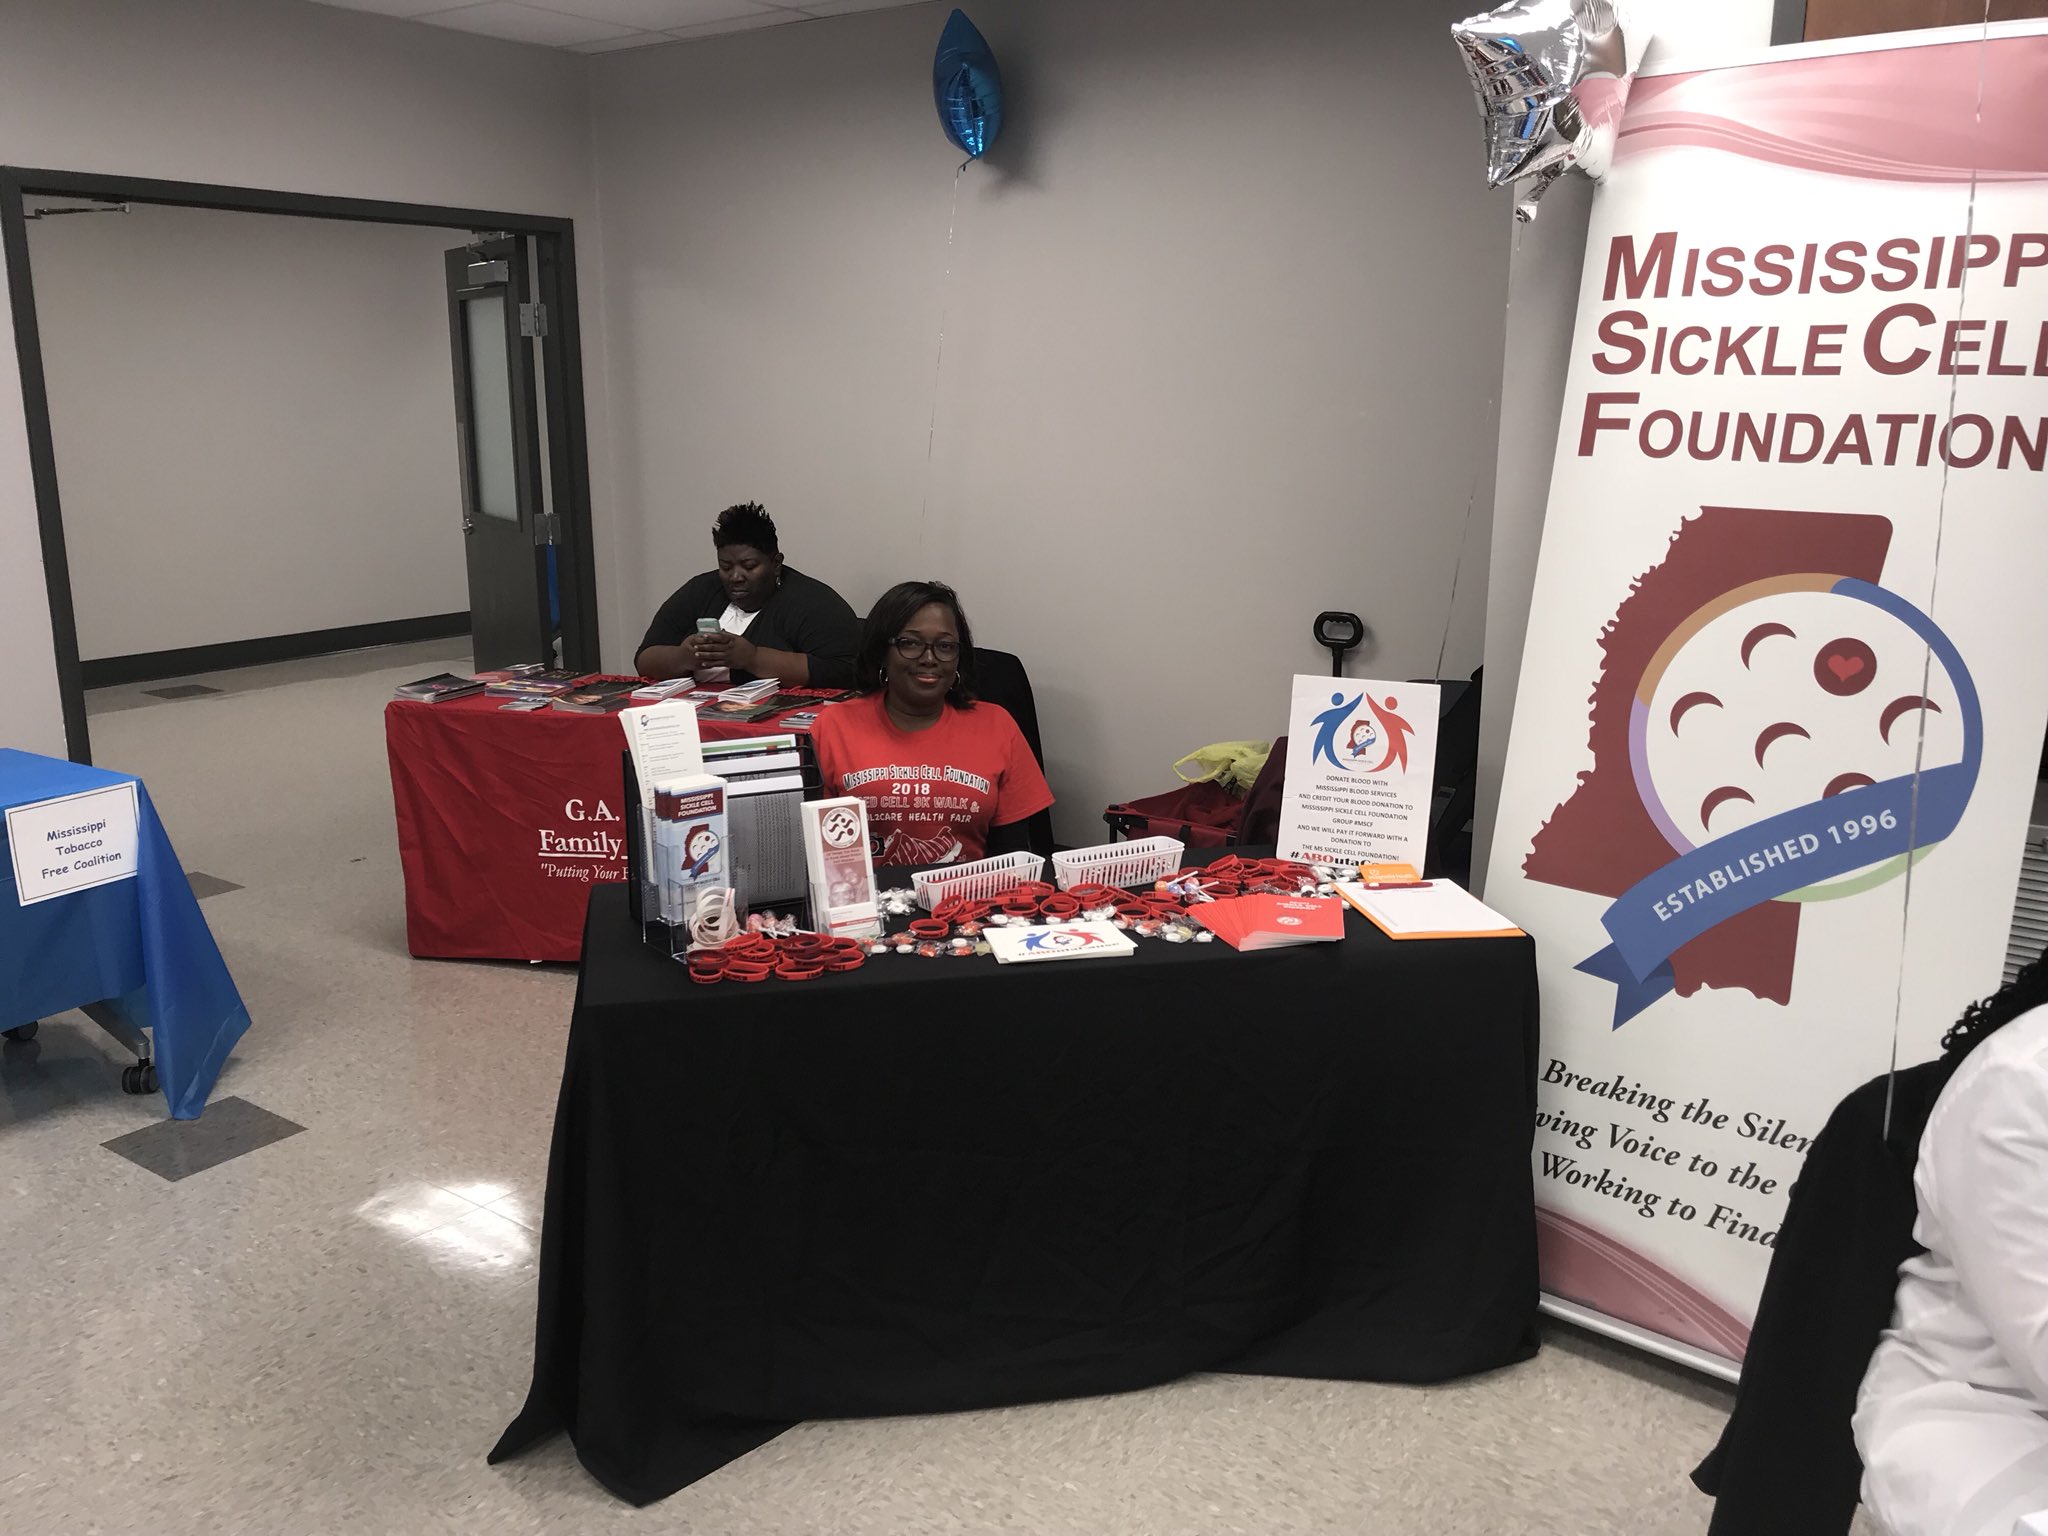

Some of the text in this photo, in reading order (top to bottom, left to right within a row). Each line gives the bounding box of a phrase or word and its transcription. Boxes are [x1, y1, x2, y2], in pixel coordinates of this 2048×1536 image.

[1592, 310, 1848, 376] SICKLE
[1578, 392, 2048, 472] FOUNDATION
[843, 767, 888, 791] MISSISSIPPI
[920, 764, 942, 780] CELL
[943, 765, 990, 795] FOUNDATION
[1326, 775, 1388, 787] DONATE BLOOD WITH
[892, 783, 930, 795] 2018
[1316, 784, 1348, 793] MISSISSIPPI
[1370, 790, 1397, 798] SERVICES
[565, 799, 620, 822] G.A.
[861, 796, 878, 808] ED
[880, 796, 910, 809] CELL
[934, 796, 968, 809] WALK
[970, 801, 980, 813] &
[1312, 794, 1332, 802] CREDIT
[1372, 801, 1404, 810] DONATION
[908, 813, 944, 821] HEALTH
[950, 813, 972, 823] FAIR
[1301, 804, 1334, 812] MISSISSIPPI
[1335, 807, 1353, 815] SICKLE
[1368, 811, 1408, 820] FOUNDATION
[47, 819, 106, 842] Mississippi
[1355, 831, 1385, 840] FORWARD
[56, 838, 103, 856] Tobacco
[538, 829, 622, 860] Family
[1324, 846, 1342, 854] SICKLE
[1330, 837, 1362, 846] DONATION
[41, 851, 122, 879] Free Coalition
[592, 865, 620, 880] Your
[1652, 809, 1897, 922] ESTABLISHED 1996
[1540, 1059, 1675, 1123] Breaking
[1680, 1098, 1729, 1130] the
[1609, 1123, 1681, 1166] Voice
[1688, 1153, 1718, 1177] to
[1727, 1162, 1777, 1195] the
[1541, 1151, 1661, 1219] Working
[1667, 1197, 1697, 1221] to
